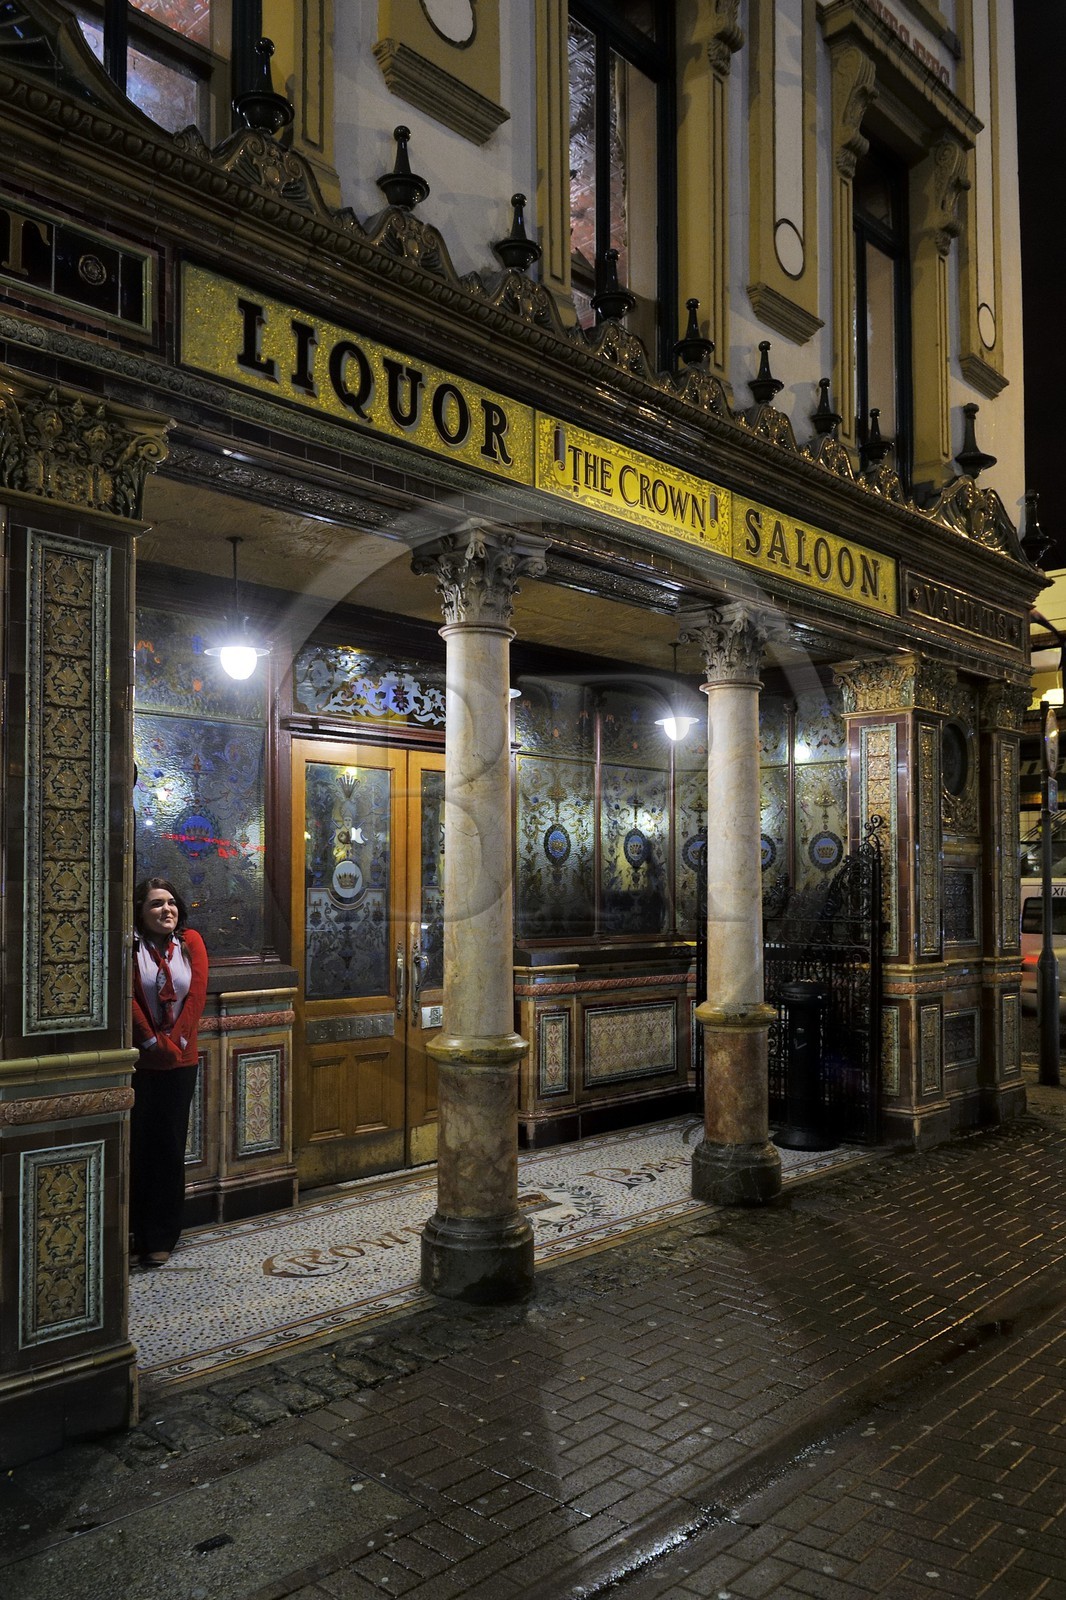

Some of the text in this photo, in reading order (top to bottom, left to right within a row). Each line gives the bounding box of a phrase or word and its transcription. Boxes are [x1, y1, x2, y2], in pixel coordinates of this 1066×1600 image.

[237, 298, 514, 468] LIQUOR
[568, 444, 706, 532] THE CROWN
[923, 584, 1007, 641] VAULTS
